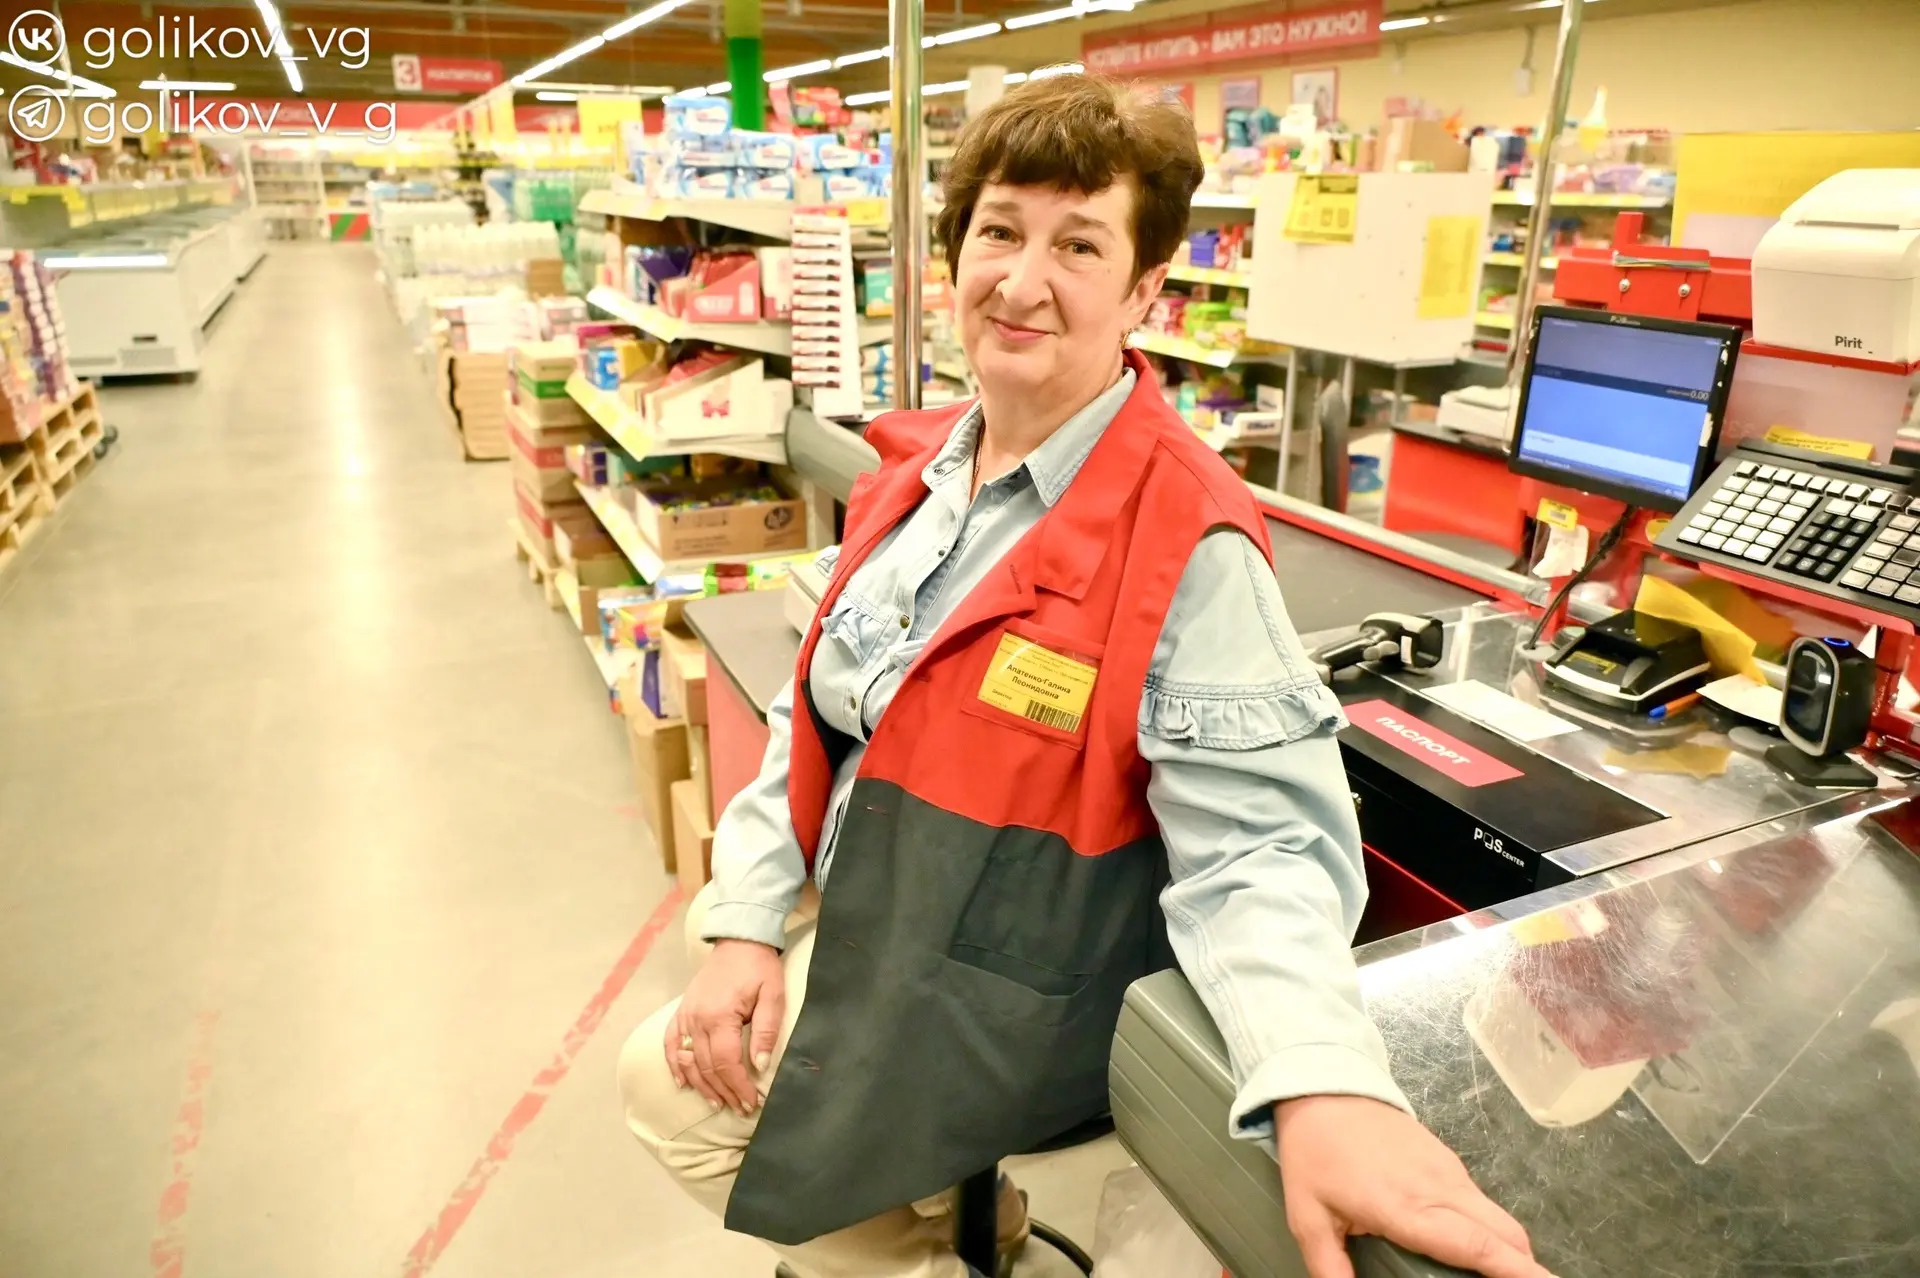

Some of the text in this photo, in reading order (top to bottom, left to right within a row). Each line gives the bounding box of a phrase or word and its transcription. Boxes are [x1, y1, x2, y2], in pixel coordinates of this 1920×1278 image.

[1211, 29, 1246, 53] ВАМ
[1248, 22, 1285, 48] ЭТО
[1288, 10, 1368, 42] НУЖНО!
[398, 60, 416, 84] 3
[1835, 335, 1863, 349] Pirit
[1007, 664, 1071, 695] Апатенко Галина
[1012, 676, 1059, 700] Леонидовна
[1375, 716, 1472, 765] ПАСПОРТ
[1501, 850, 1525, 868] CENTER
